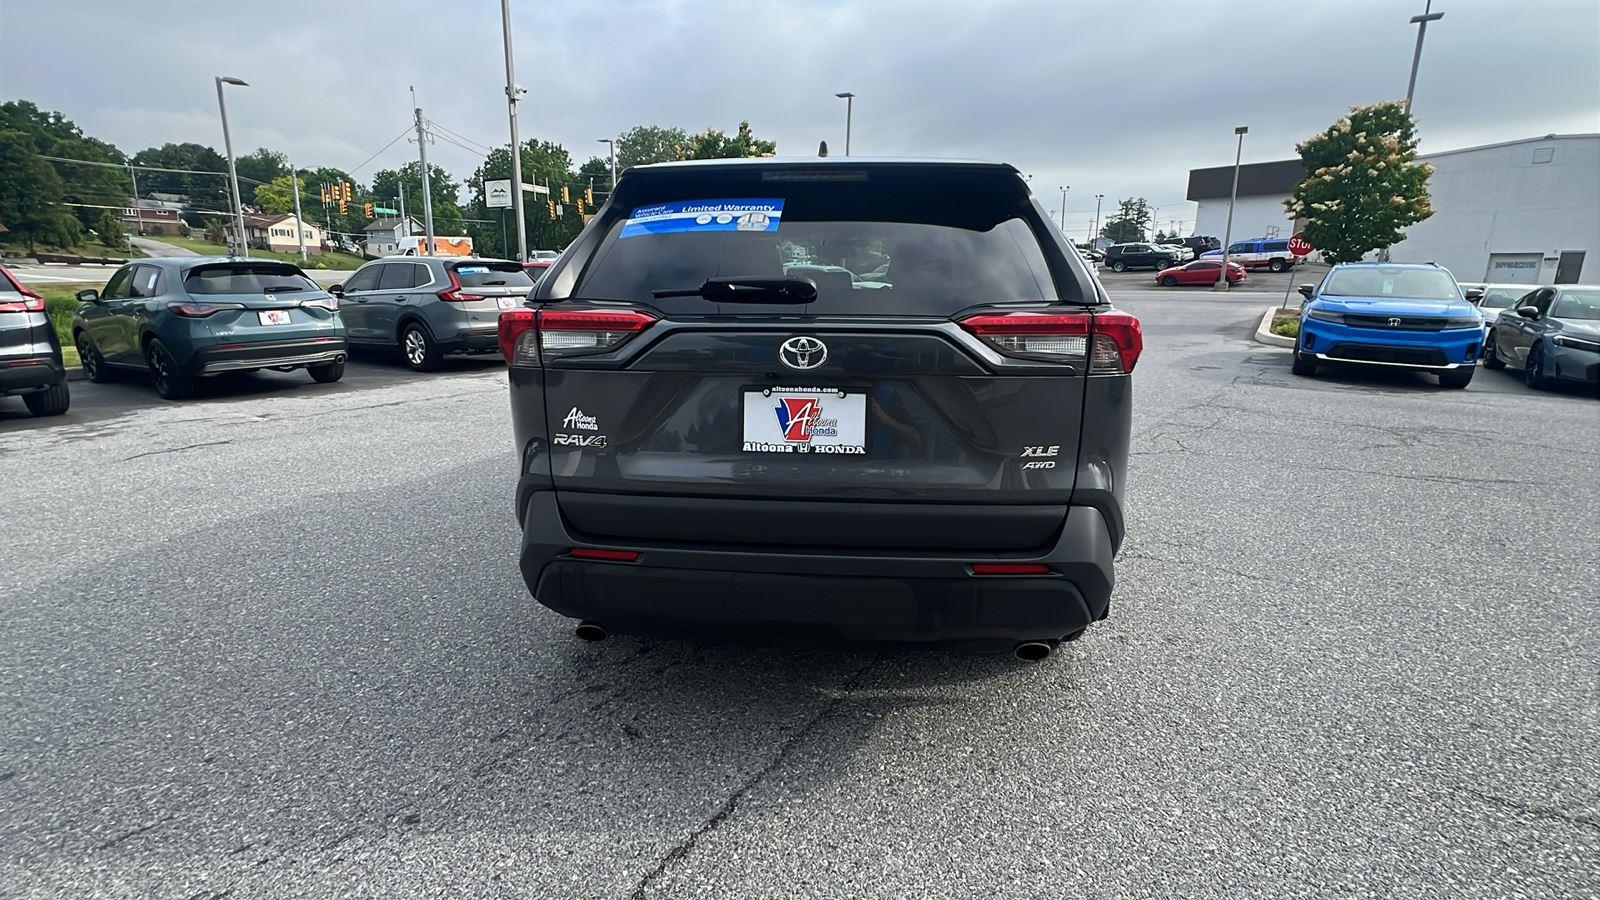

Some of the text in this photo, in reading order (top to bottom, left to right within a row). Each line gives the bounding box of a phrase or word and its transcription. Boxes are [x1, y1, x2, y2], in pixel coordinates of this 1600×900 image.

[682, 204, 775, 213] Limited Warranty
[576, 421, 599, 431] Honda
[806, 426, 838, 436] Honda
[553, 433, 608, 449] RAV4
[742, 442, 794, 453] Altoona
[814, 445, 866, 454] HONDA
[1020, 445, 1060, 457] XLE
[1022, 461, 1056, 470] AWD
